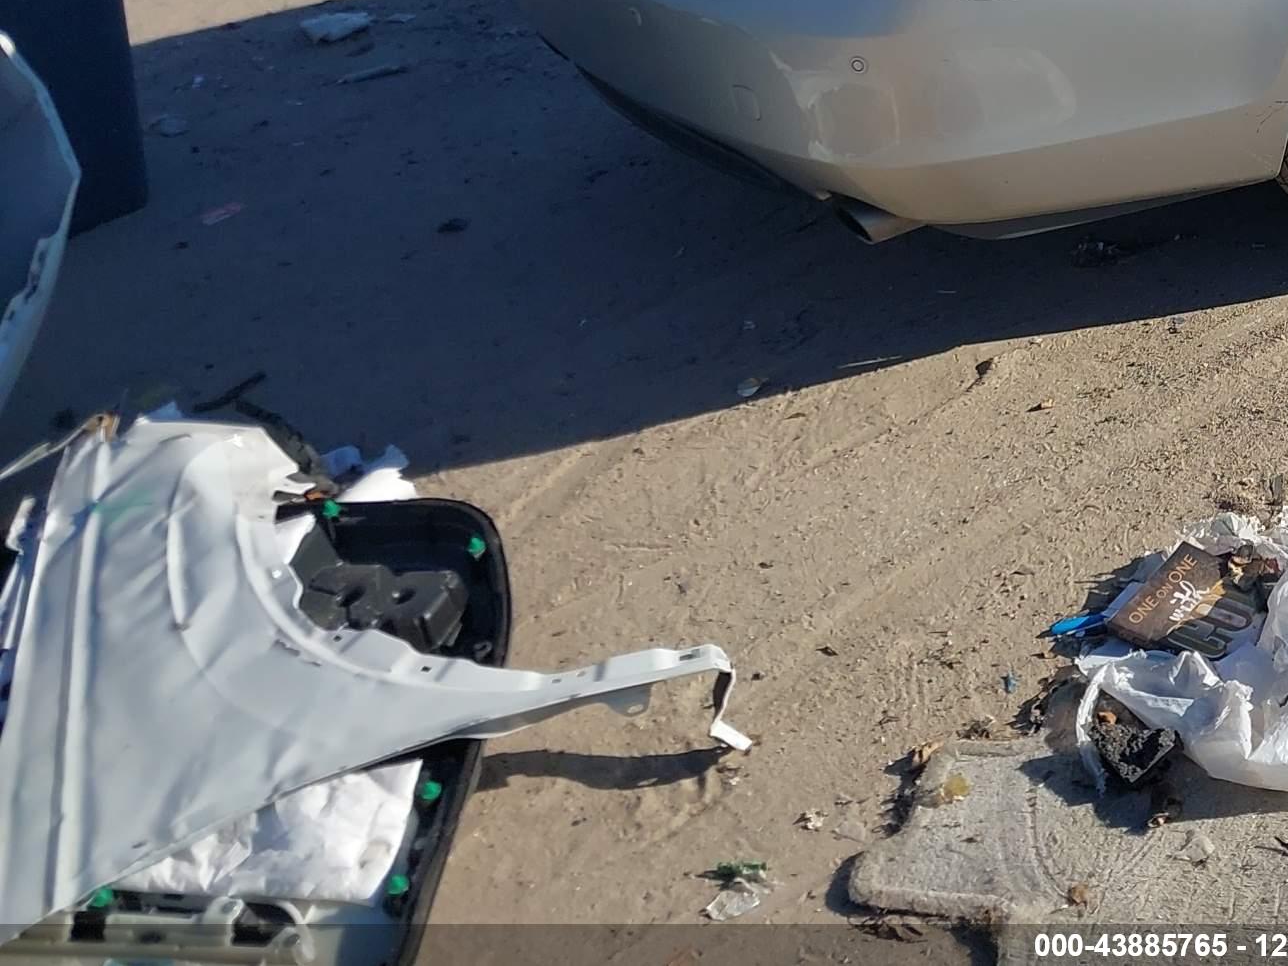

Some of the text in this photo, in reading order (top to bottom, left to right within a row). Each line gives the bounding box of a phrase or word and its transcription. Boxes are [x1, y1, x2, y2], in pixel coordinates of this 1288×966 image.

[1128, 595, 1160, 625] ONE
[1156, 584, 1174, 599] ON
[1168, 553, 1198, 583] ONE
[1169, 580, 1210, 622] with
